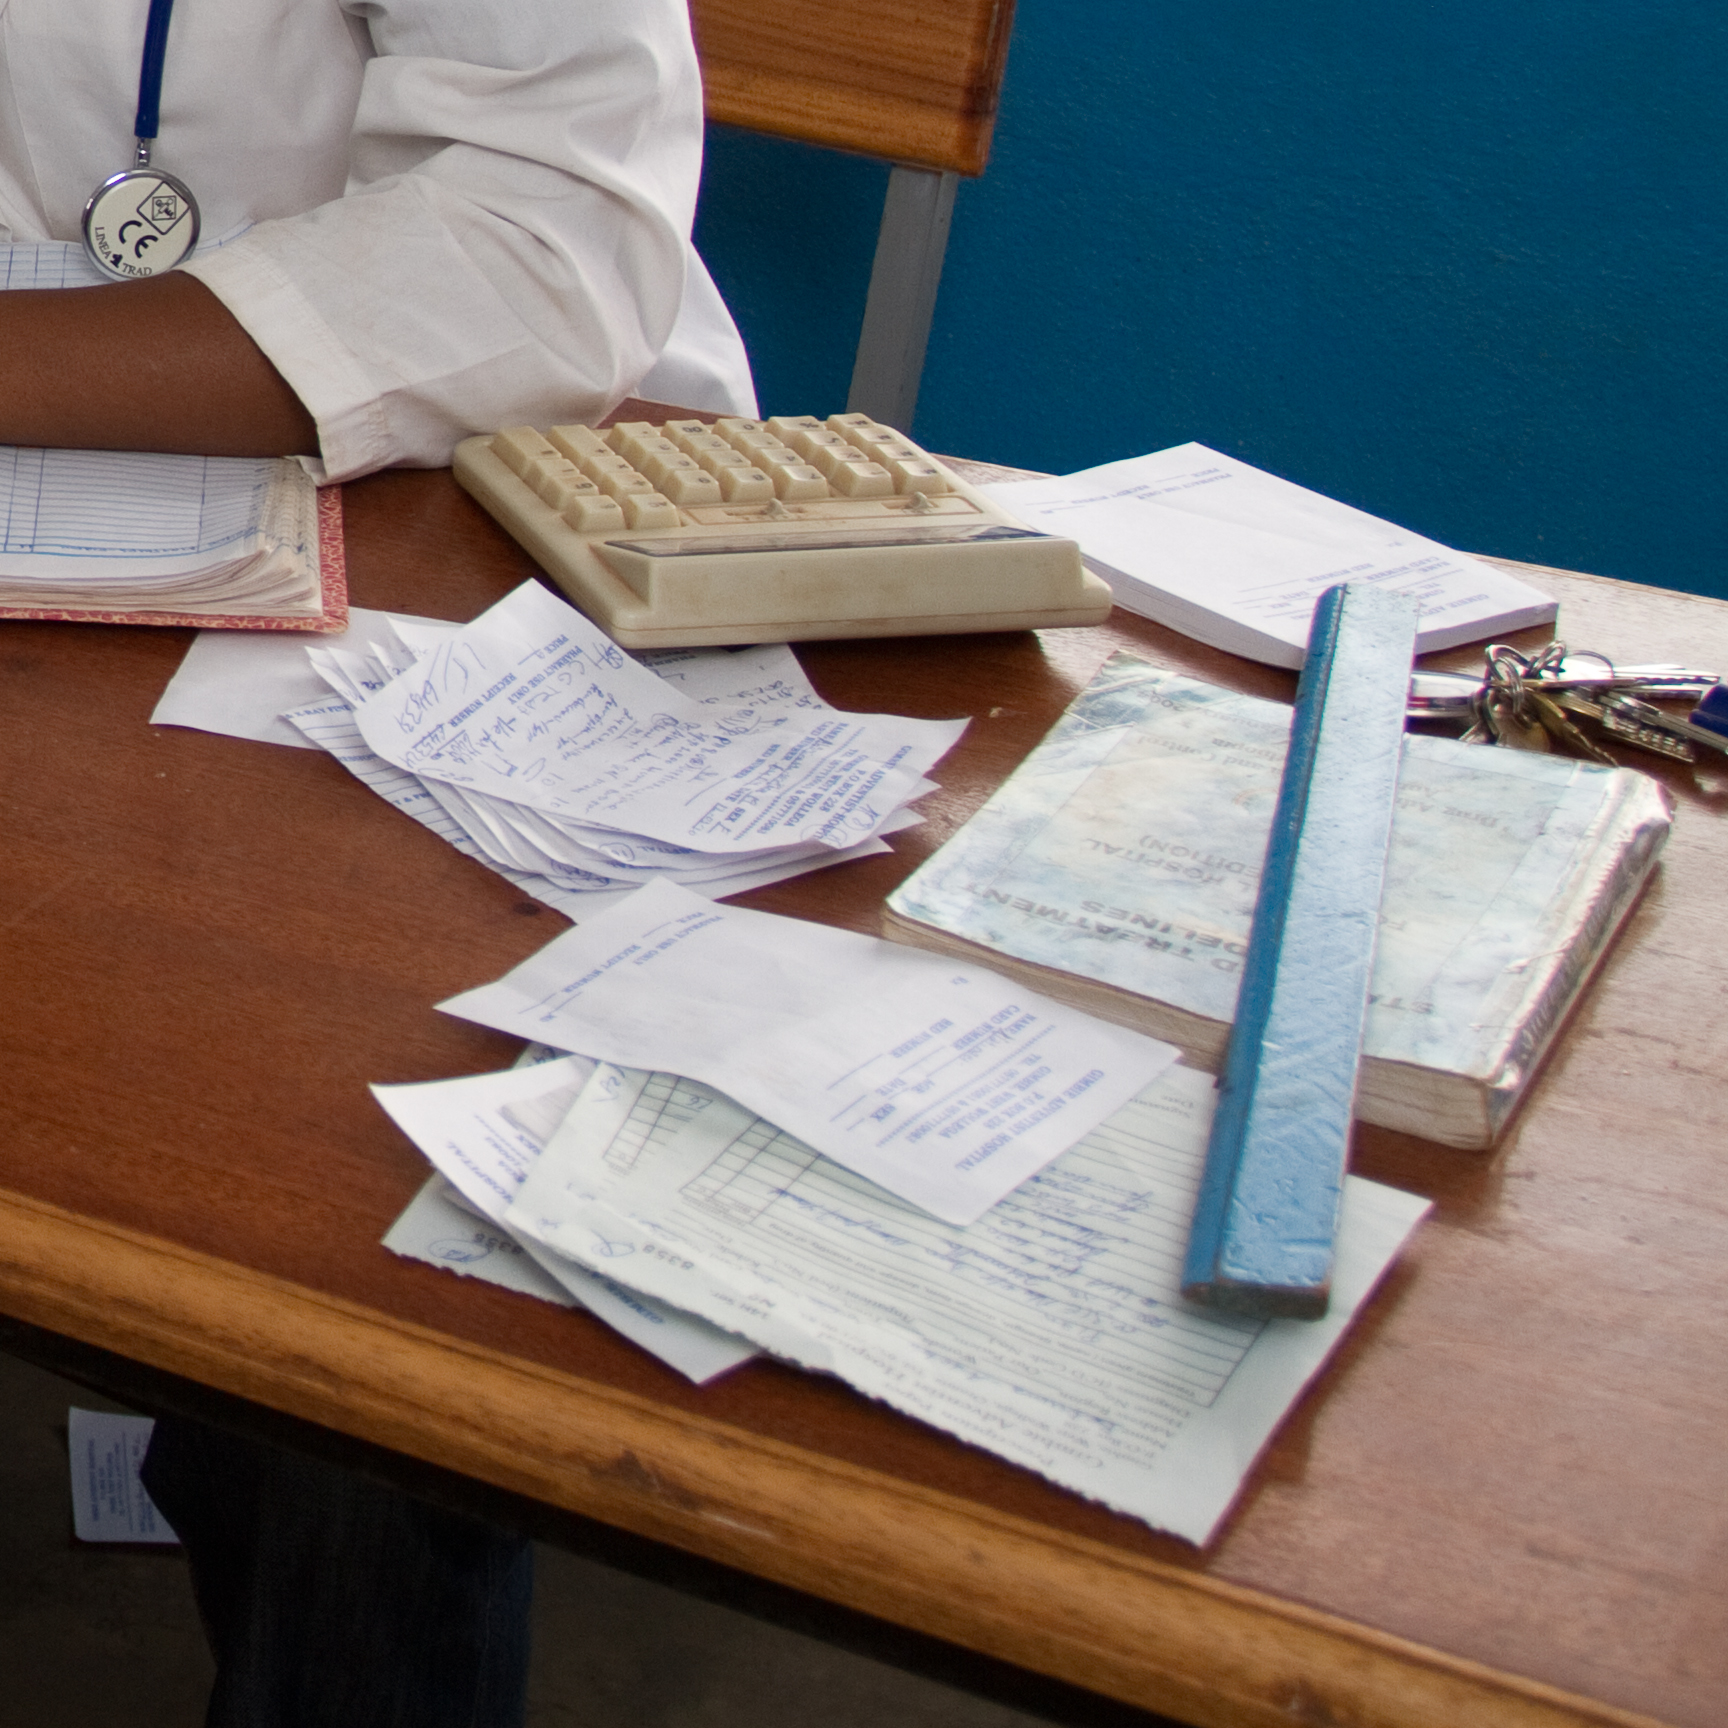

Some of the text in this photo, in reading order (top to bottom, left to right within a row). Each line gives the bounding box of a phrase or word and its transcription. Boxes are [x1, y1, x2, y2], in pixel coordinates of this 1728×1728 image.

[95, 227, 112, 259] LINEA
[122, 263, 152, 276] TRAD
[545, 635, 569, 653] PRICE
[508, 646, 583, 704] PHARMACY USE ONLY
[449, 673, 517, 727] RECEIPT NUMBER
[842, 769, 885, 813] ADVENTIST
[1082, 899, 1248, 956] DELINES
[1011, 1096, 1067, 1135] ADVENTIST
[956, 1134, 1011, 1171] HOSPITAL
